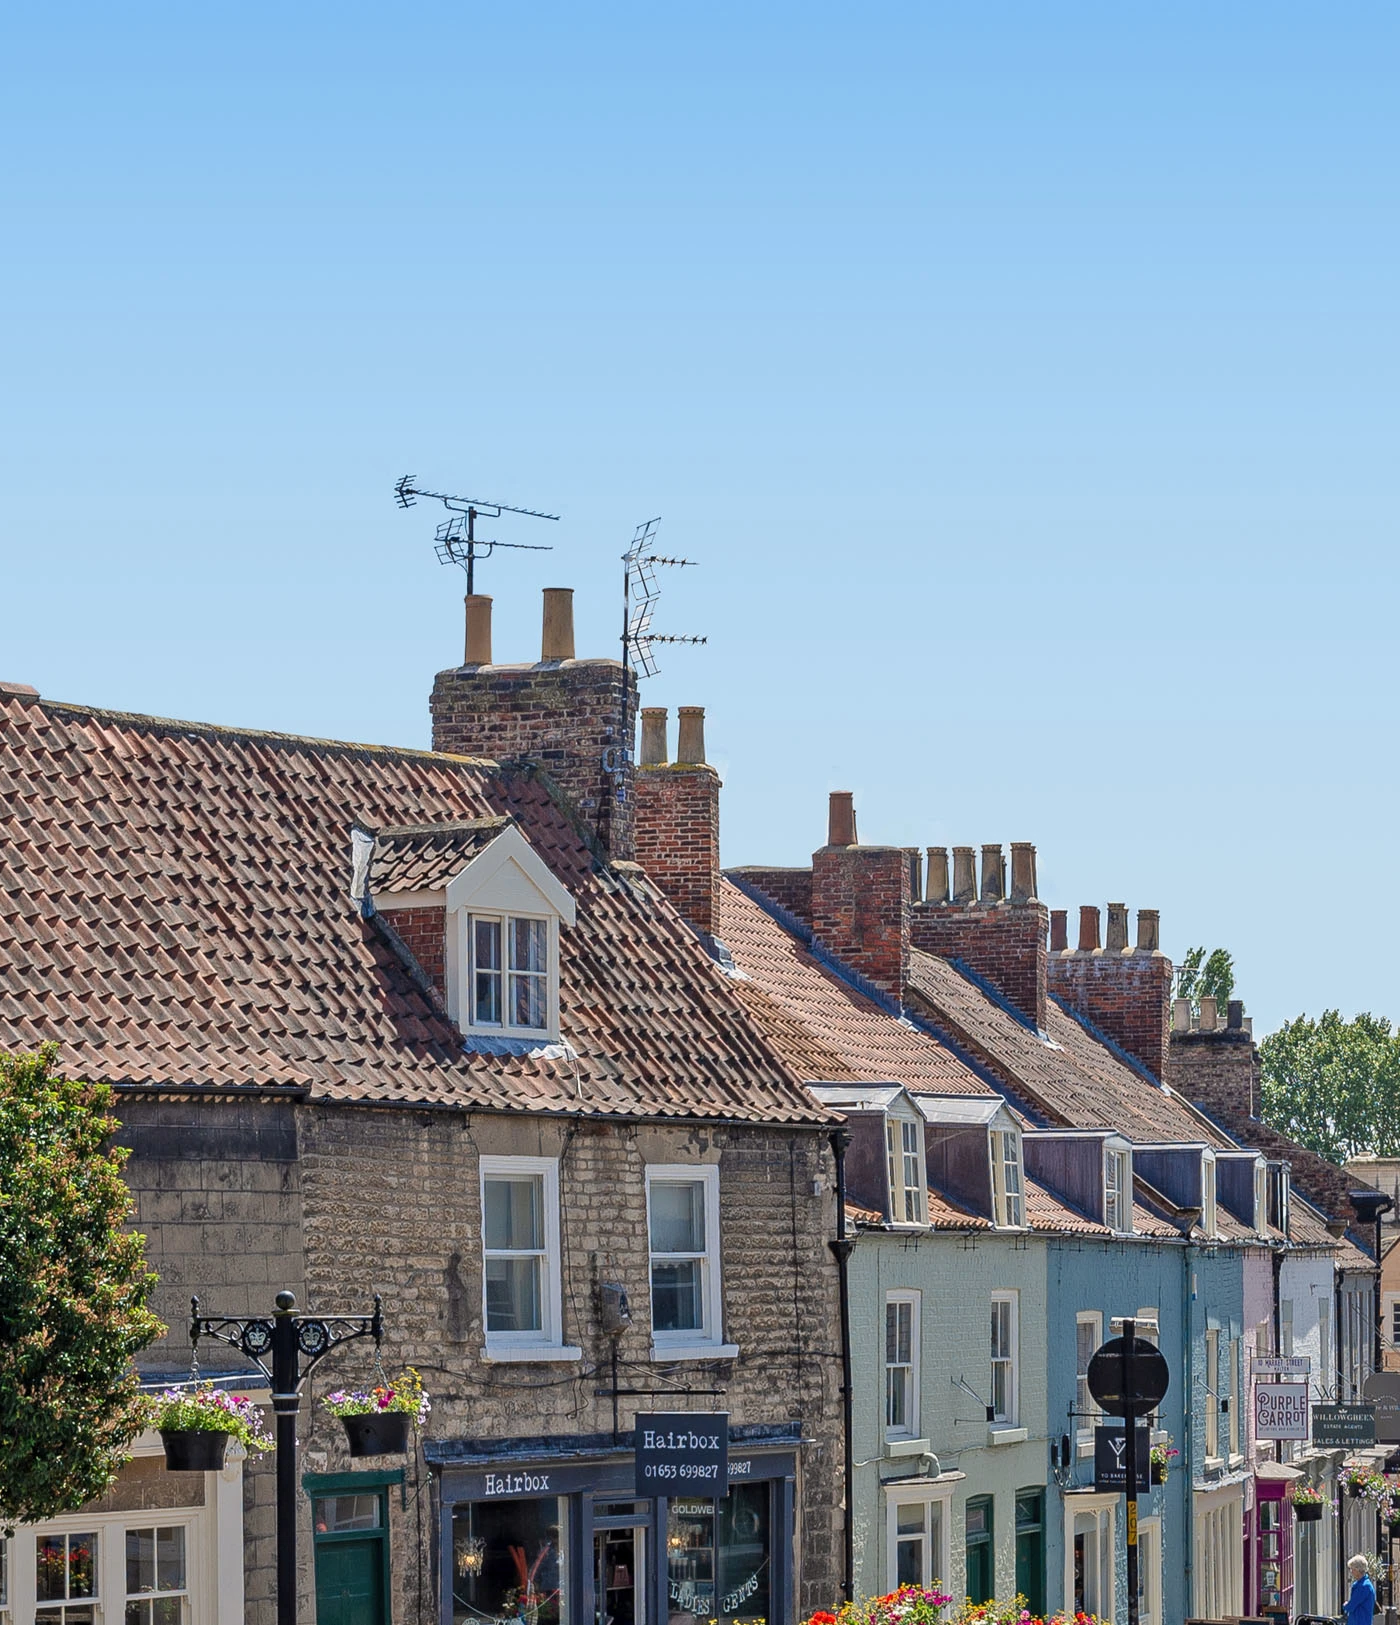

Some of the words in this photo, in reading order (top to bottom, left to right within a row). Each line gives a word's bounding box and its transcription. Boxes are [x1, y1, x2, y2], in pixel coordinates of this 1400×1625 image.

[1257, 1392, 1306, 1411] PURPLE
[1257, 1410, 1306, 1426] CARROT
[1312, 1413, 1375, 1421] WILLOWGREEN
[643, 1431, 720, 1450] Hairbox
[1341, 1437, 1375, 1445] LETTINGS
[644, 1464, 678, 1479] 01653
[679, 1464, 719, 1479] 699827
[485, 1471, 550, 1495] Hairbox
[670, 1582, 710, 1616] LADIES
[722, 1574, 759, 1613] GENTS
